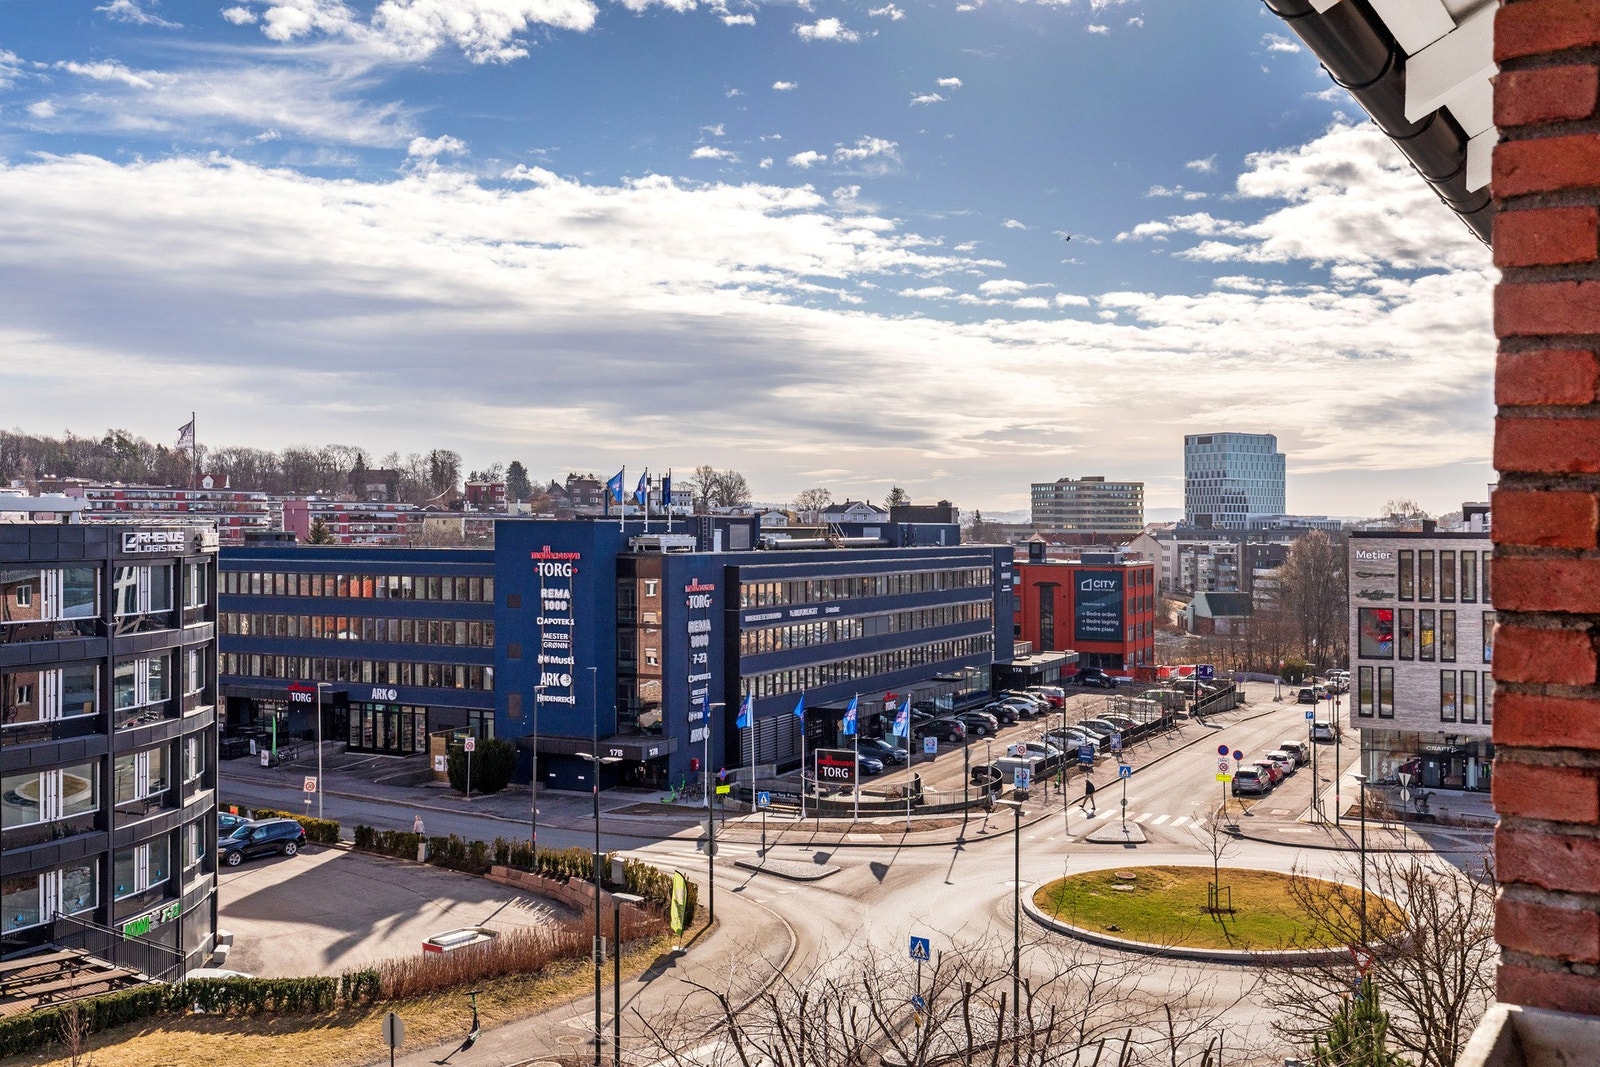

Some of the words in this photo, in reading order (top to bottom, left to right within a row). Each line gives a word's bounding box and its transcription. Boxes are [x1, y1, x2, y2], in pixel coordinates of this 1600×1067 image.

[138, 532, 184, 543] RHENUS
[139, 544, 184, 553] LOGISTICS
[1356, 550, 1391, 559] Metier
[537, 563, 572, 577] TORG
[1093, 580, 1115, 588] CITY
[541, 588, 571, 599] REMA
[544, 600, 568, 611] 1000
[688, 595, 710, 609] TORG
[688, 619, 711, 633] REMA
[543, 632, 569, 640] MESTER
[550, 655, 575, 665] Musti
[693, 652, 707, 664] 7-23
[1206, 667, 1213, 675] P
[540, 672, 560, 687] ARK
[291, 692, 312, 703] TORG
[371, 687, 388, 700] ARK
[536, 694, 576, 705] HEIDENREICH
[609, 748, 624, 757] 17B
[649, 747, 659, 757] 17B
[822, 766, 849, 778] TORG
[123, 914, 150, 940] KIWI
